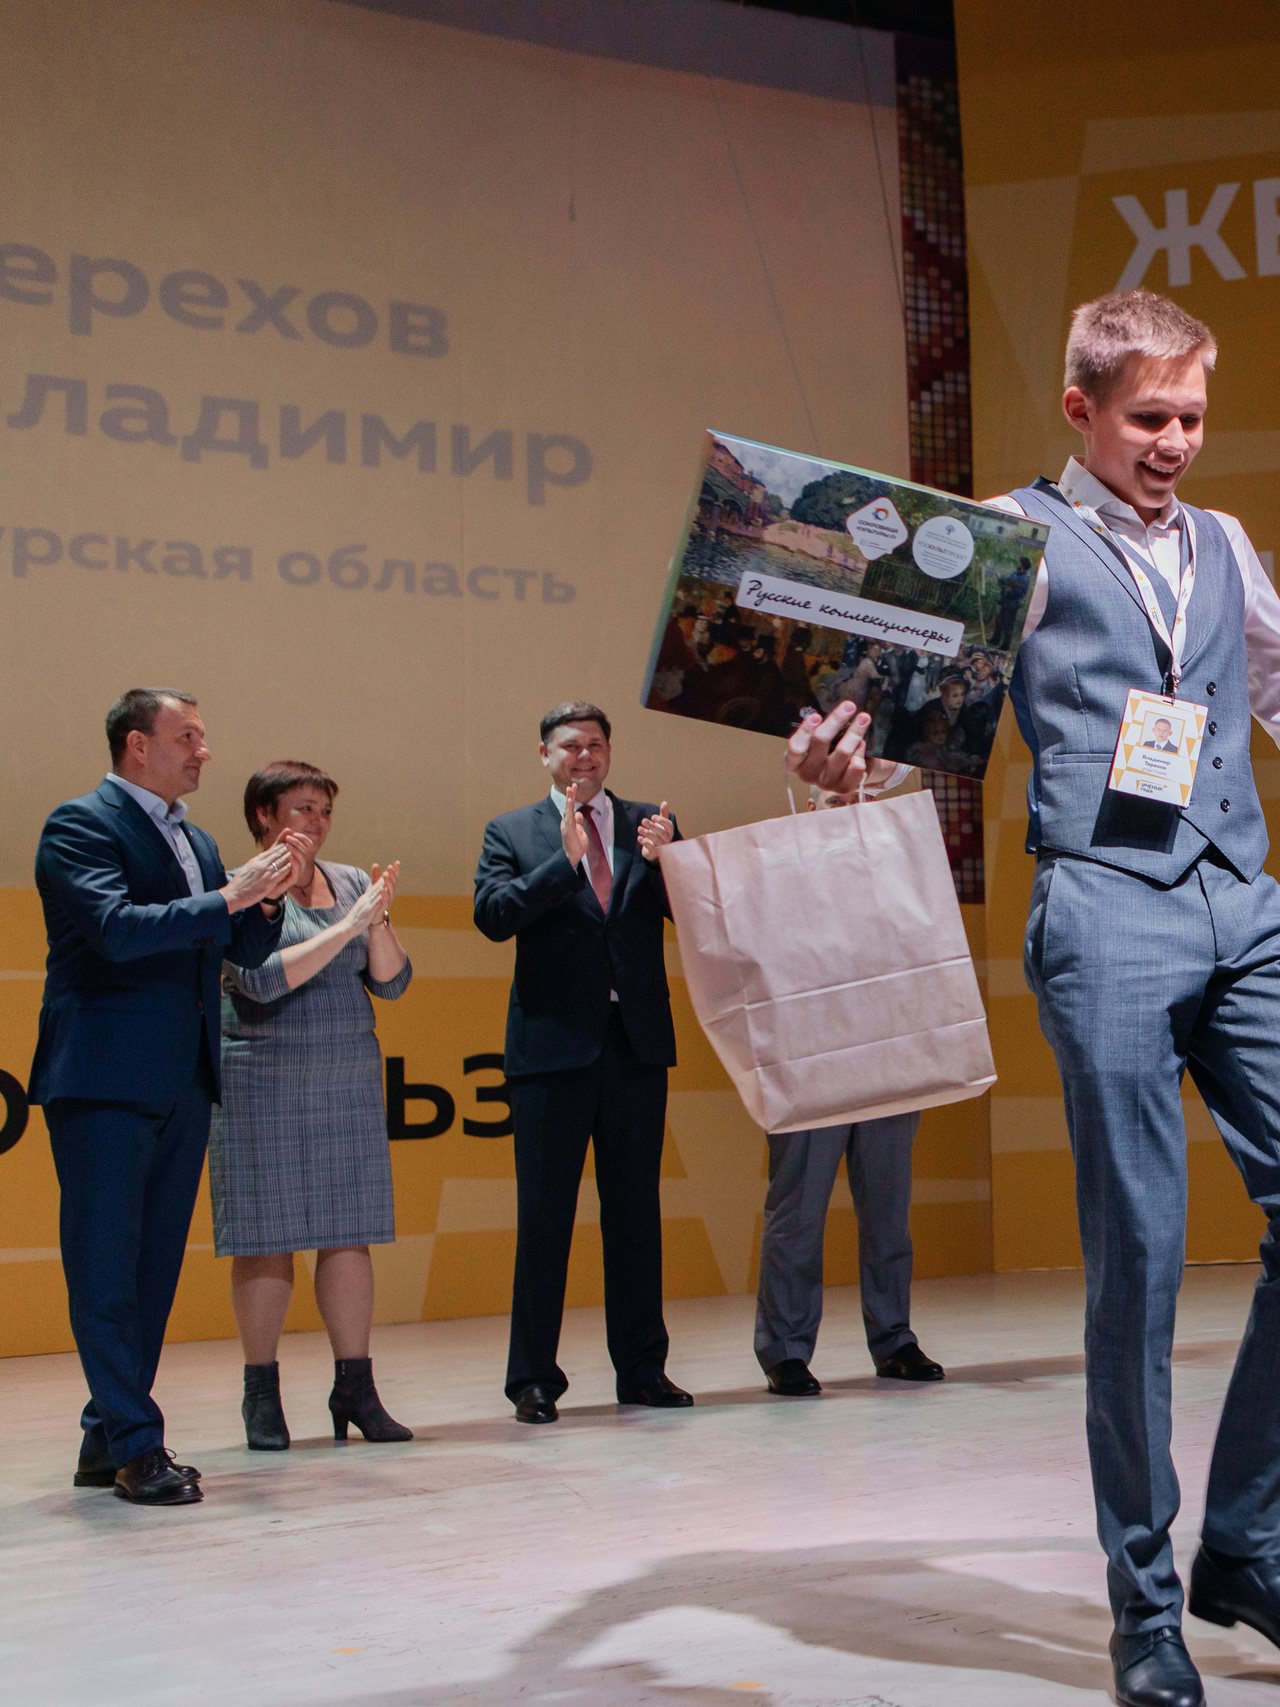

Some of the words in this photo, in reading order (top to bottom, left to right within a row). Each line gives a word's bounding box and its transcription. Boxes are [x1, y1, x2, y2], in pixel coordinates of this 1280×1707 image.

[6, 372, 594, 507] ладимир
[276, 543, 577, 605] область
[746, 579, 813, 609] Русские
[818, 603, 954, 647] коллекционеры
